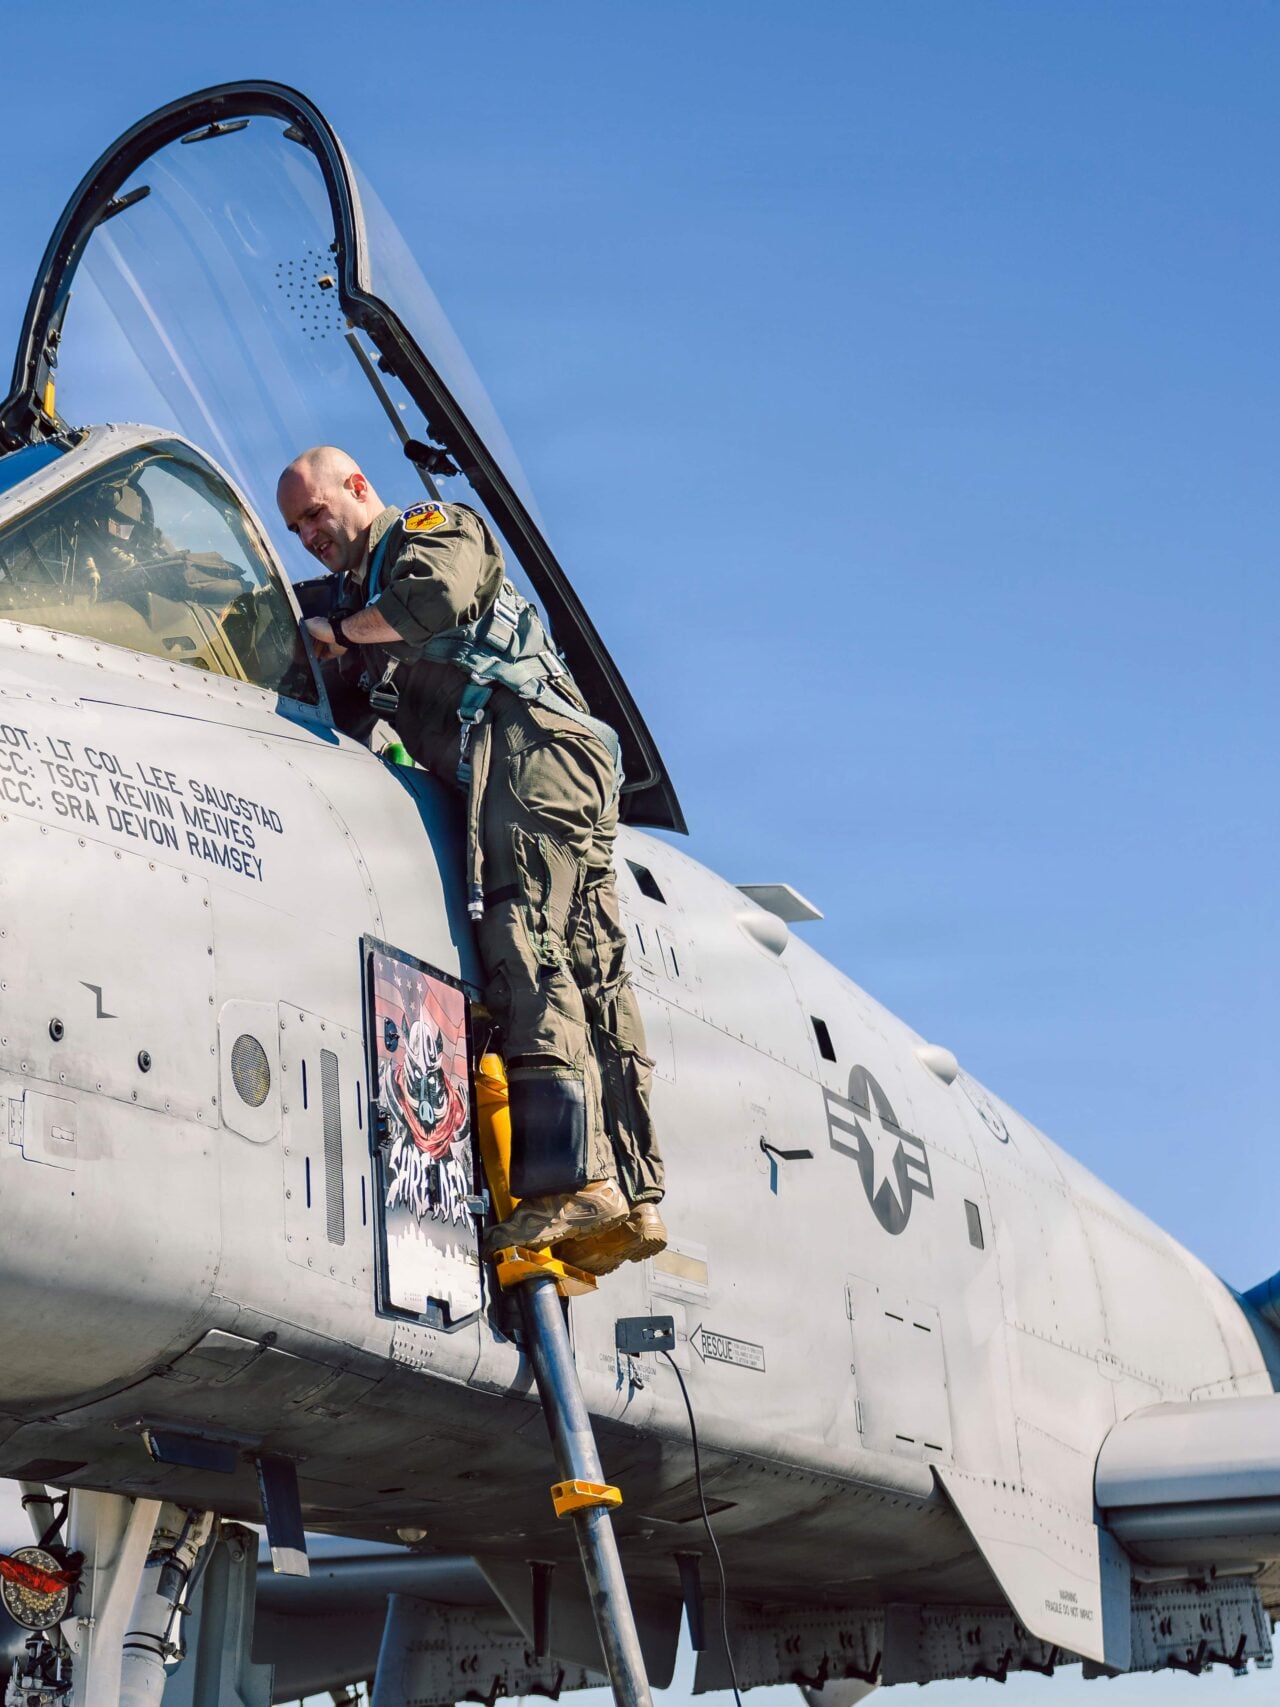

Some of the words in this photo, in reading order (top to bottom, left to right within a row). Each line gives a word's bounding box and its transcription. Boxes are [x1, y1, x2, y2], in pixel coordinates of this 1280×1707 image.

[40, 759, 100, 796] TSGT
[109, 779, 174, 820] KEVIN
[180, 801, 256, 849] MEIVES
[46, 736, 74, 762] LT
[84, 747, 133, 779] COL
[136, 762, 183, 796] LEE
[188, 779, 283, 834] SAUGSTAD
[51, 790, 99, 825] SRA
[106, 805, 179, 850] DEVON
[186, 831, 263, 882] RAMSEY
[385, 1136, 474, 1239] SHREDER
[701, 1334, 733, 1360] RESCUE
